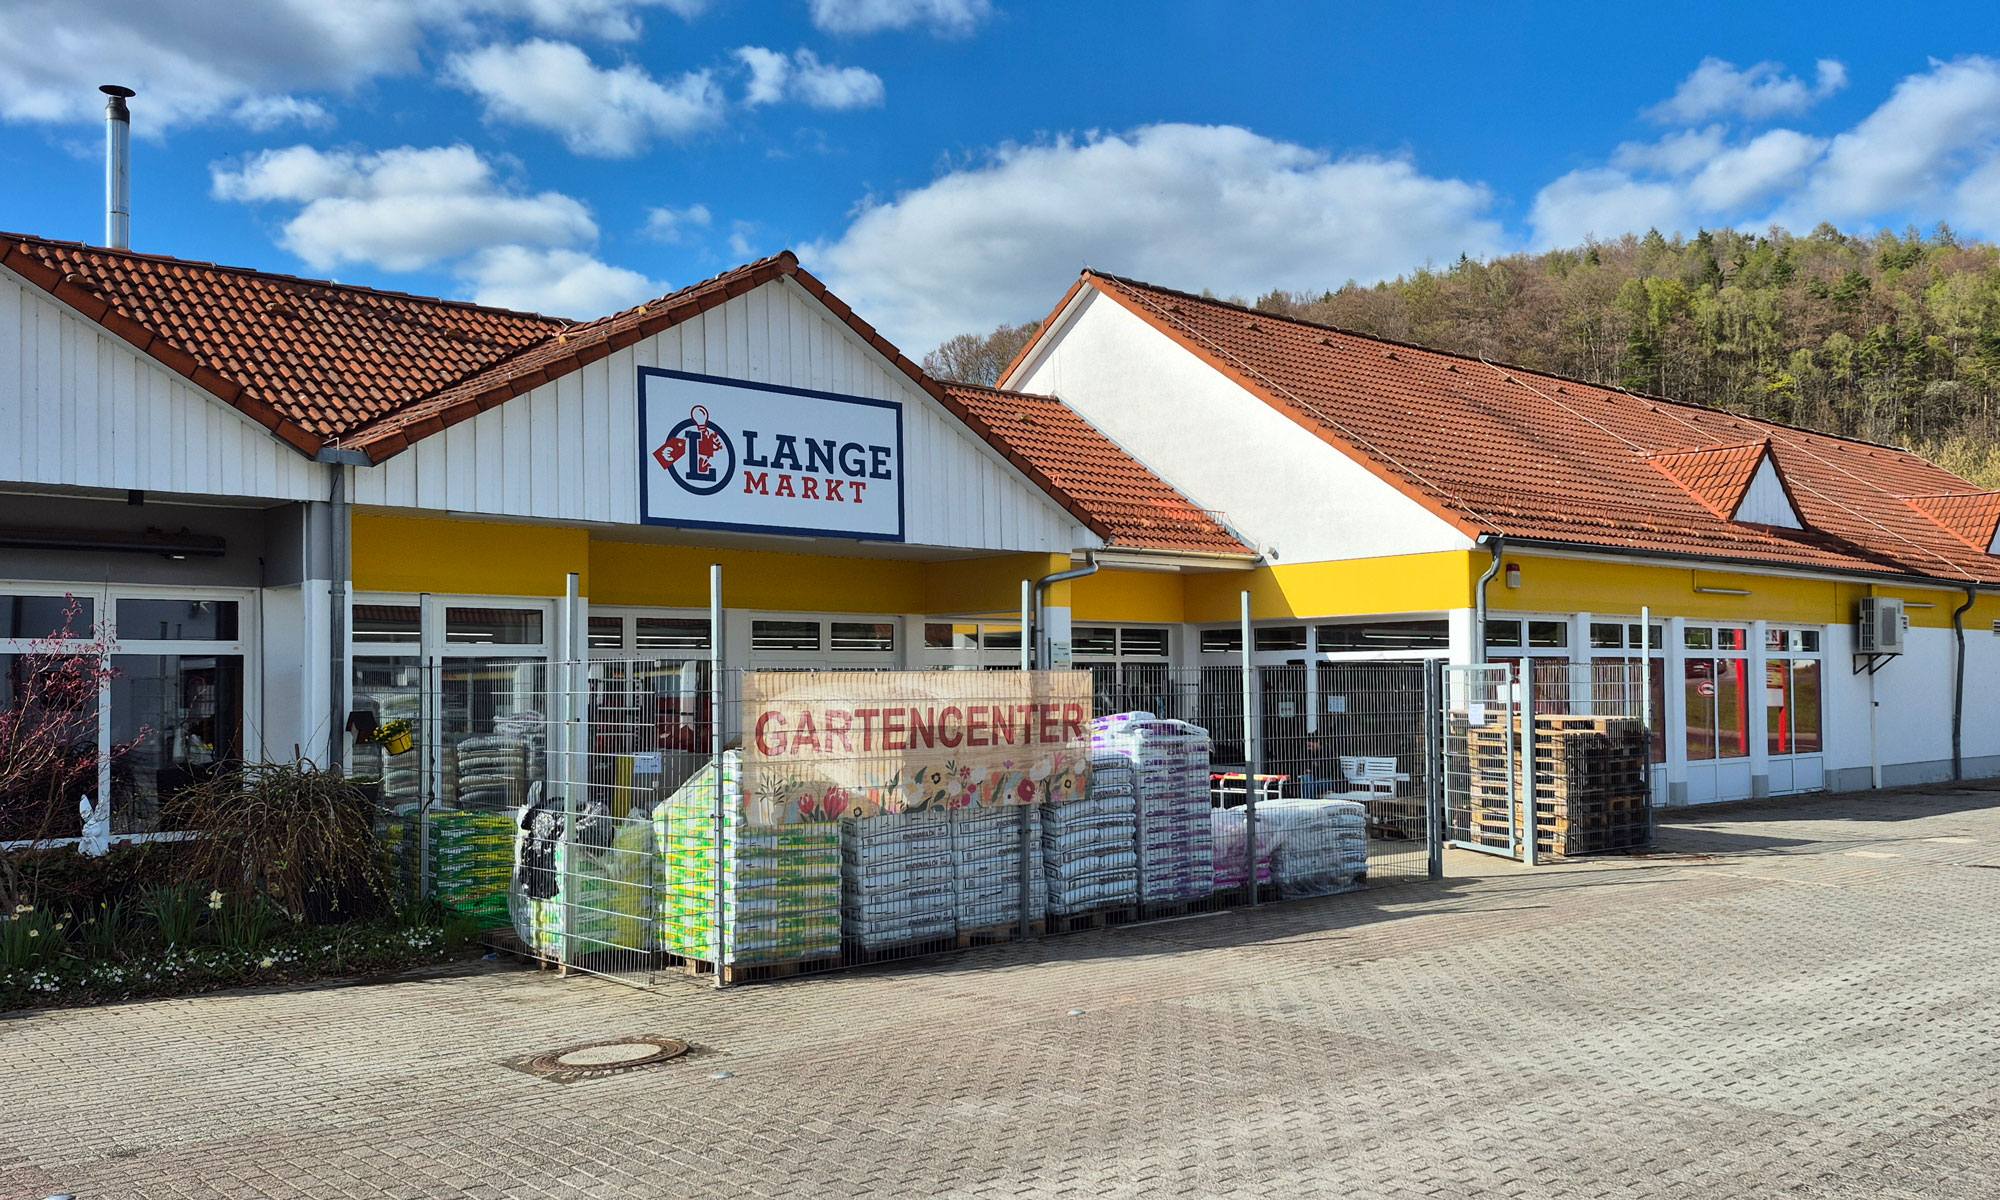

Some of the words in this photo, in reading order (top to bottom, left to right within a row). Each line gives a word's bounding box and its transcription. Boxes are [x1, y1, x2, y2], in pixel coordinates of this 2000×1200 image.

[742, 430, 892, 480] LANGE
[743, 471, 867, 504] MARKT
[755, 703, 1084, 757] GARTENCENTER
